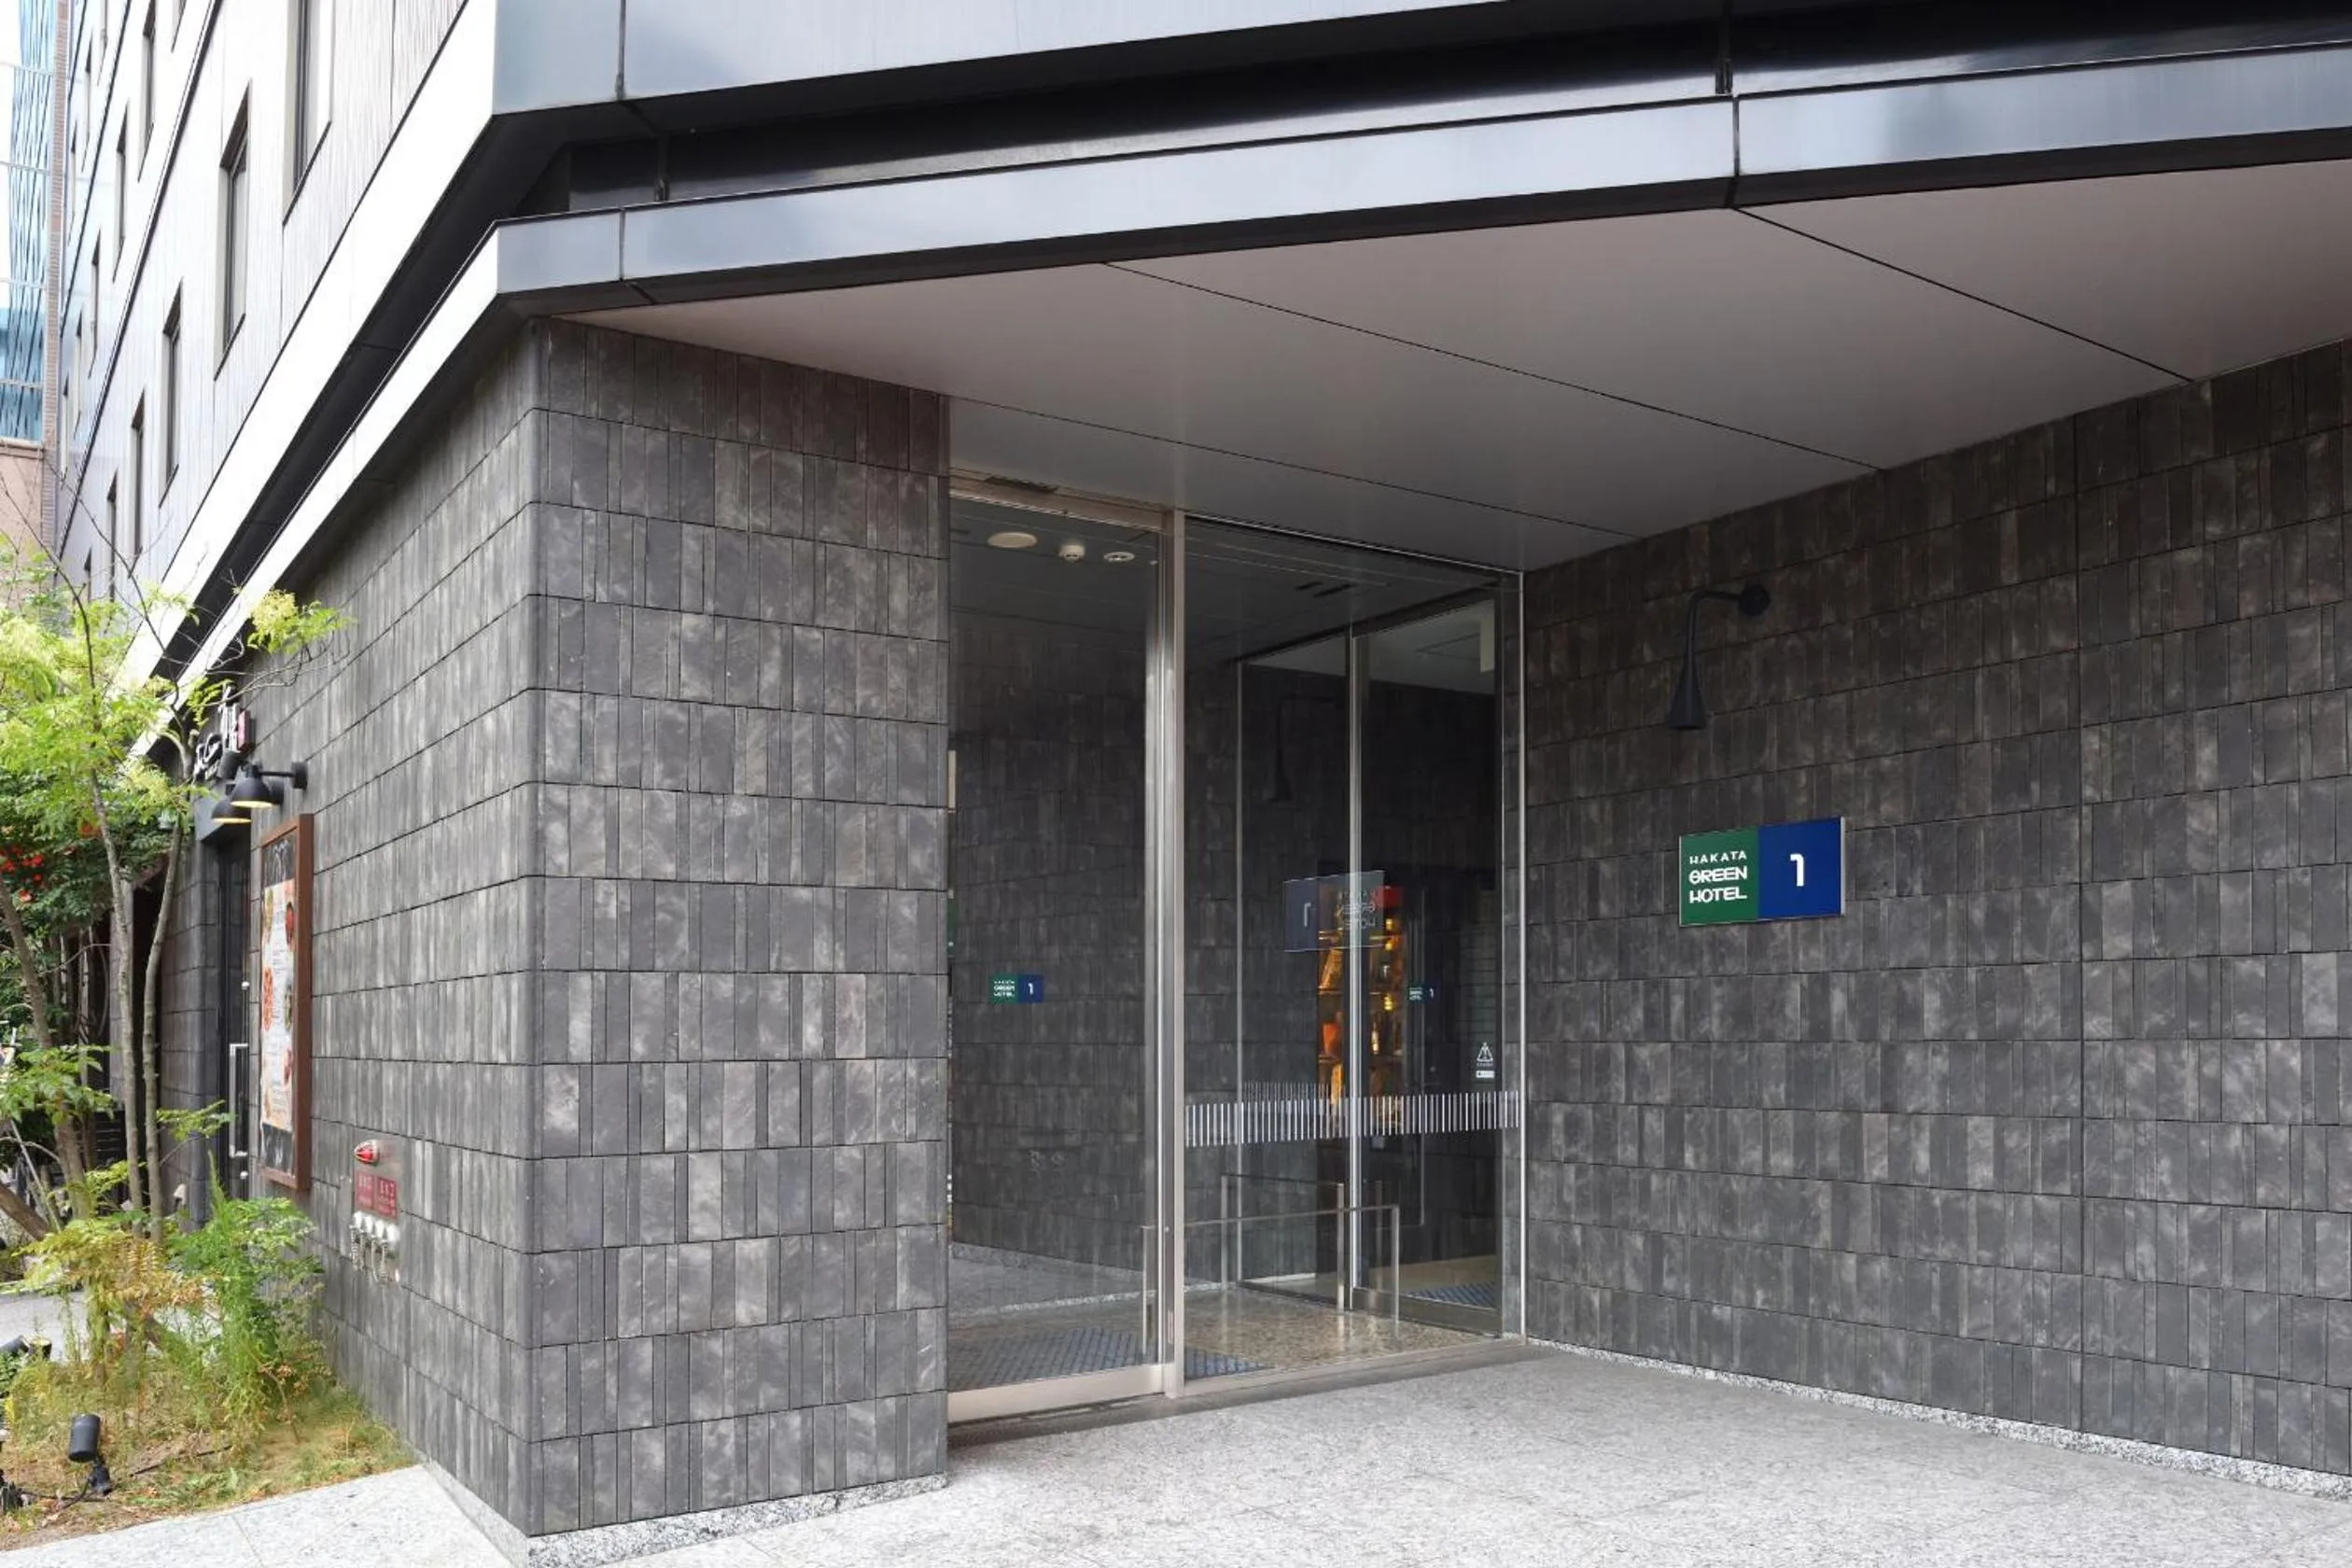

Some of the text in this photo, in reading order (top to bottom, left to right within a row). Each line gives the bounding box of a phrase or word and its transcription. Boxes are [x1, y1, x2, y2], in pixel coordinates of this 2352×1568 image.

[1689, 850, 1746, 864] HAKATA
[1688, 866, 1747, 884] GREEN
[1790, 853, 1804, 887] 1
[1689, 887, 1747, 903] HOTEL
